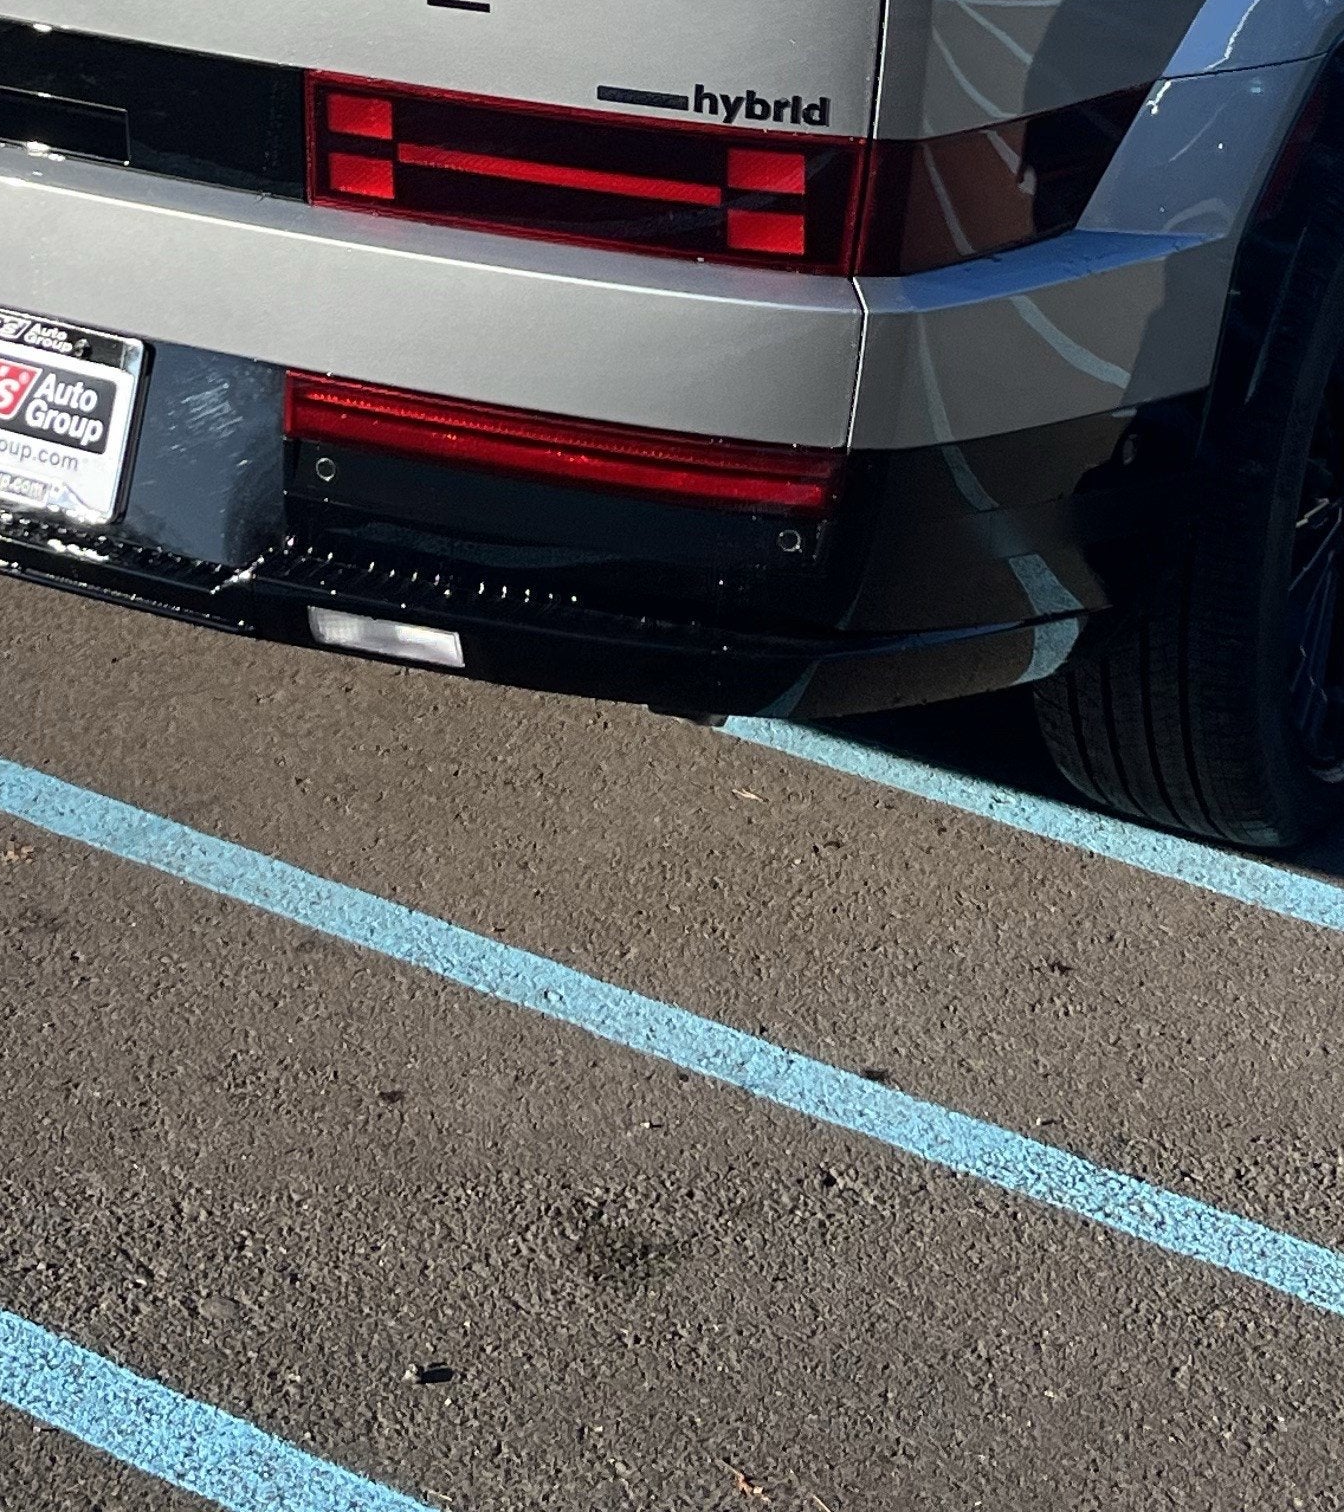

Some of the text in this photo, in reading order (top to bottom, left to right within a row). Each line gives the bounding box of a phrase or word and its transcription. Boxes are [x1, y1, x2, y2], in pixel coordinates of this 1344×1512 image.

[694, 84, 831, 126] hybrid
[23, 331, 73, 354] Group
[29, 323, 68, 341] Auto
[33, 373, 97, 413] Auto
[24, 401, 103, 446] Group
